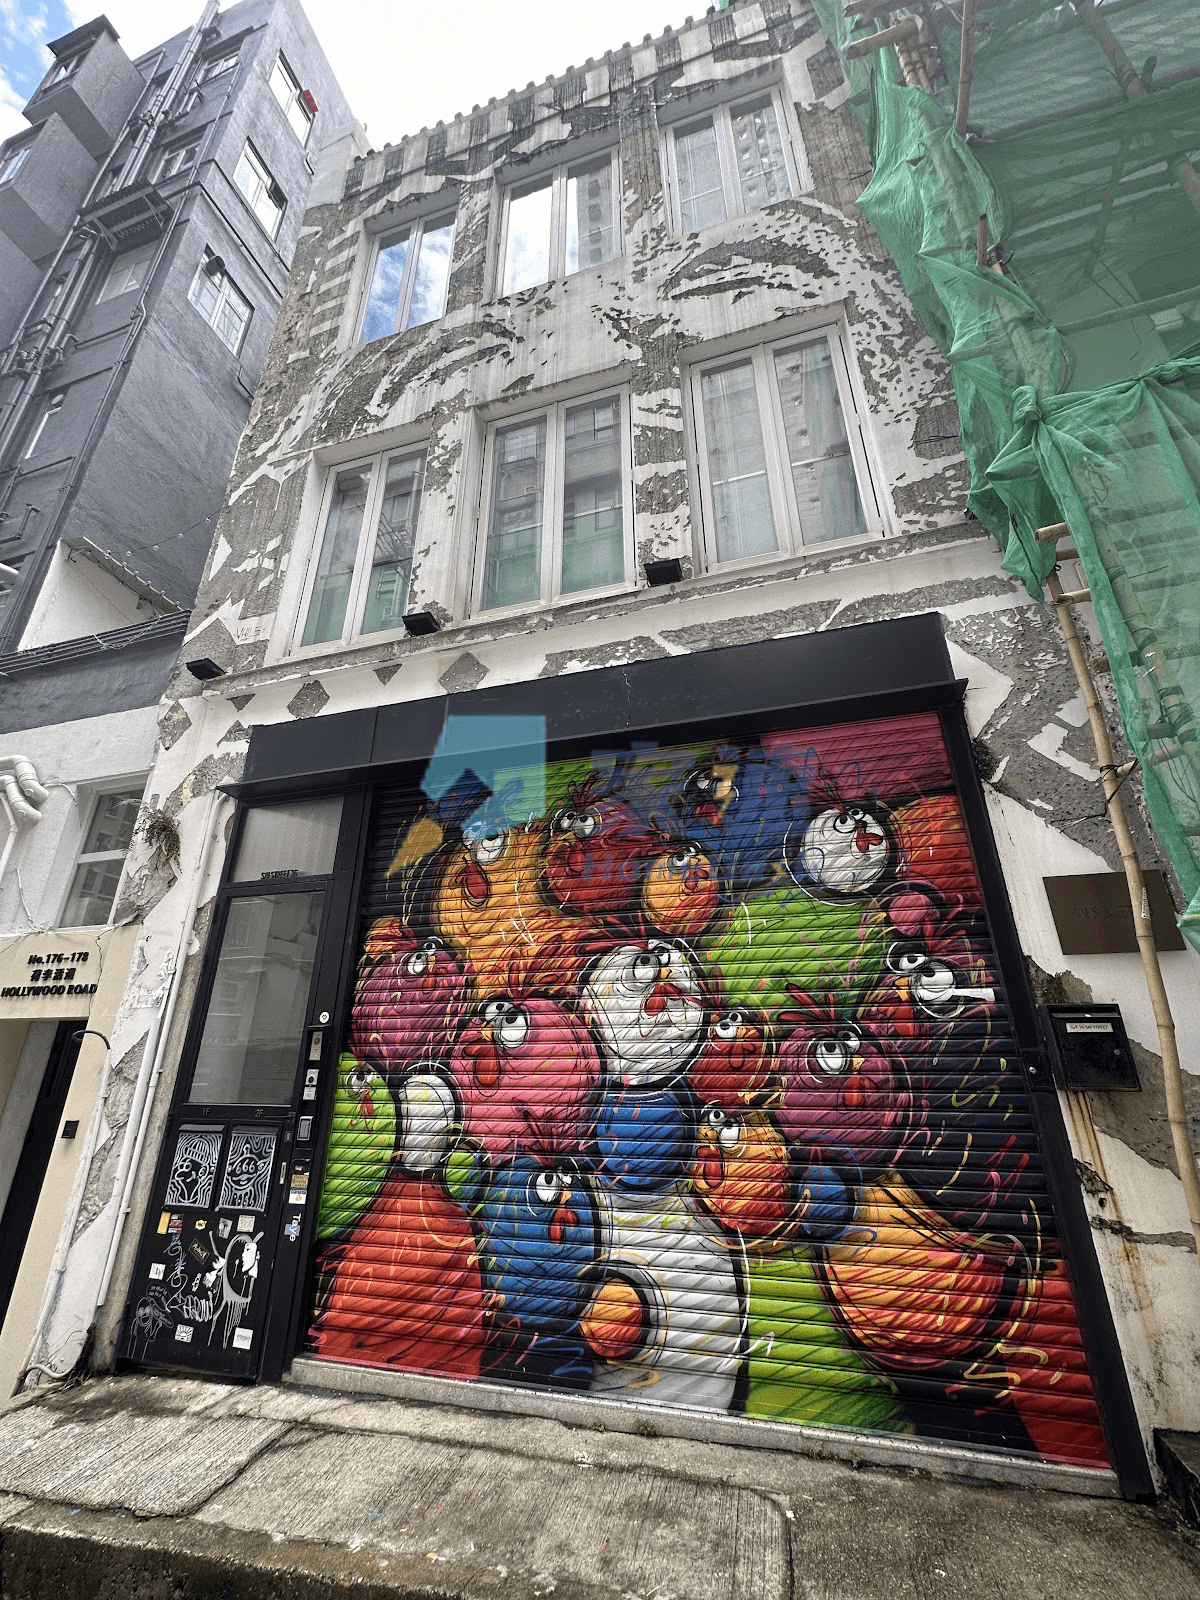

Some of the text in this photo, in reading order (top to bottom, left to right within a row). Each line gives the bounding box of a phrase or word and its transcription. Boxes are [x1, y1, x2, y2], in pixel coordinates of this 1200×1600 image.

[28, 952, 89, 965] No.176-178
[31, 968, 76, 981] 荷李活道
[1, 984, 97, 997] HOLLYWOOD ROAD
[202, 1107, 211, 1116] 1F
[255, 1108, 264, 1118] 2F
[289, 1212, 301, 1243] Taye
